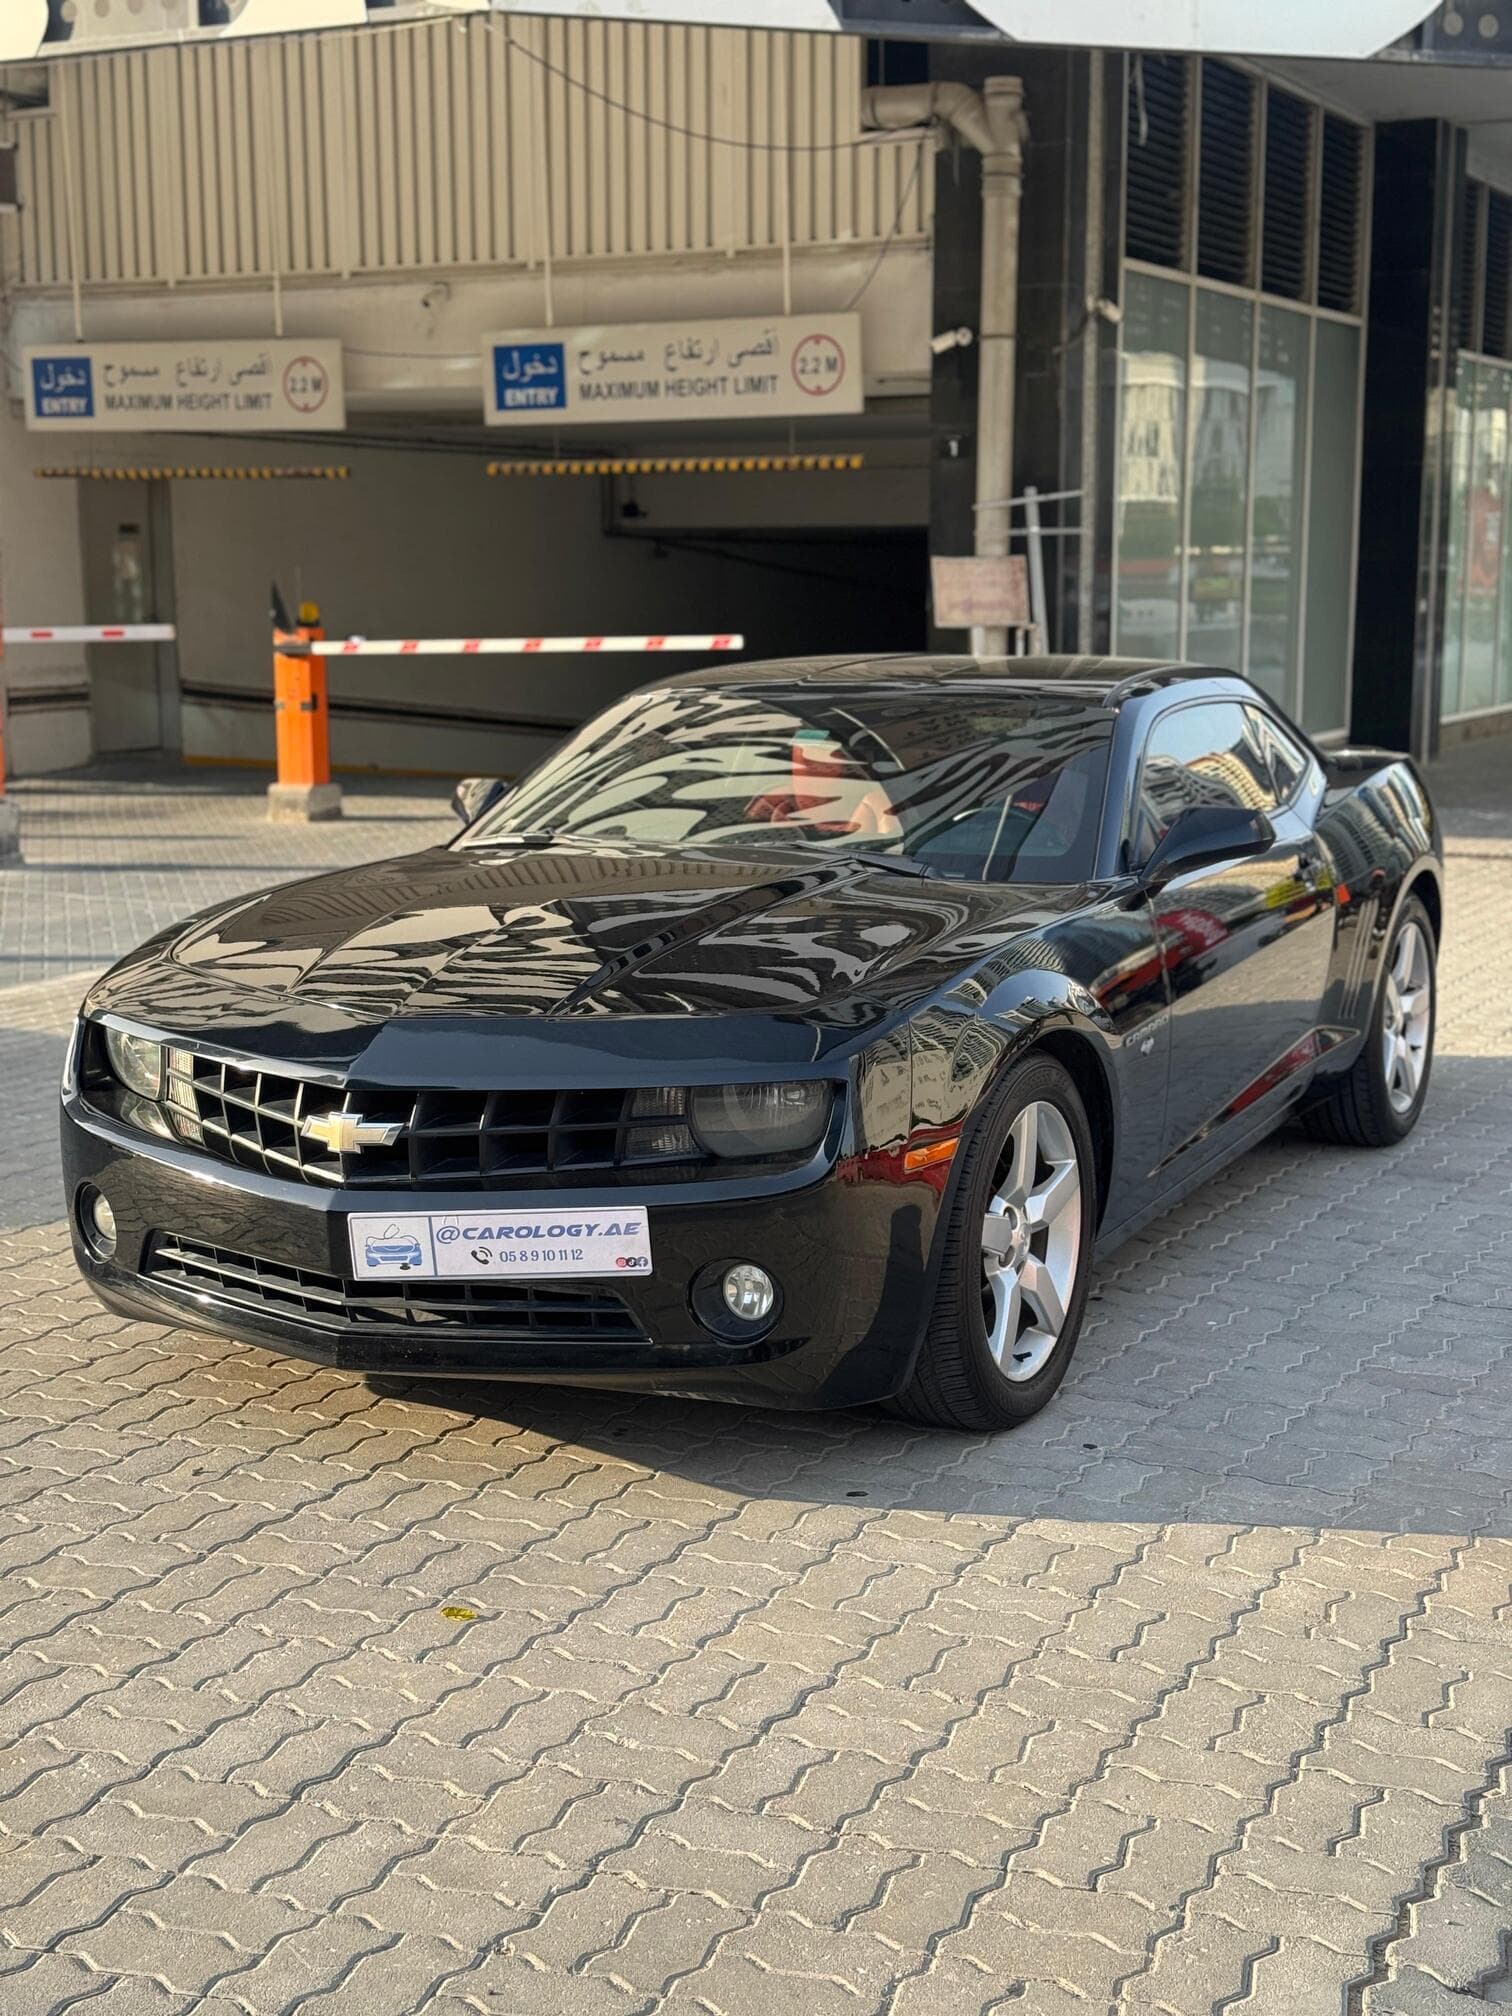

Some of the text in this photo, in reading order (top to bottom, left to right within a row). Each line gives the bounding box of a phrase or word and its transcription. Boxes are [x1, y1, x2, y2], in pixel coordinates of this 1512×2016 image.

[503, 349, 559, 383] دخول
[578, 348, 645, 375] مسموح
[799, 356, 838, 375] 2.2 M
[40, 362, 87, 393] دخول
[103, 363, 160, 388] مسموح
[289, 376, 322, 393] 2.2 M
[504, 386, 559, 407] ENTRY
[579, 374, 779, 401] MAXIMUM HEIGHT LIMIT
[41, 396, 88, 415] ENTRY
[104, 393, 272, 411] MAXIMUM HEIGHT LIMIT
[436, 1222, 642, 1244] @CAROLOGY.AE
